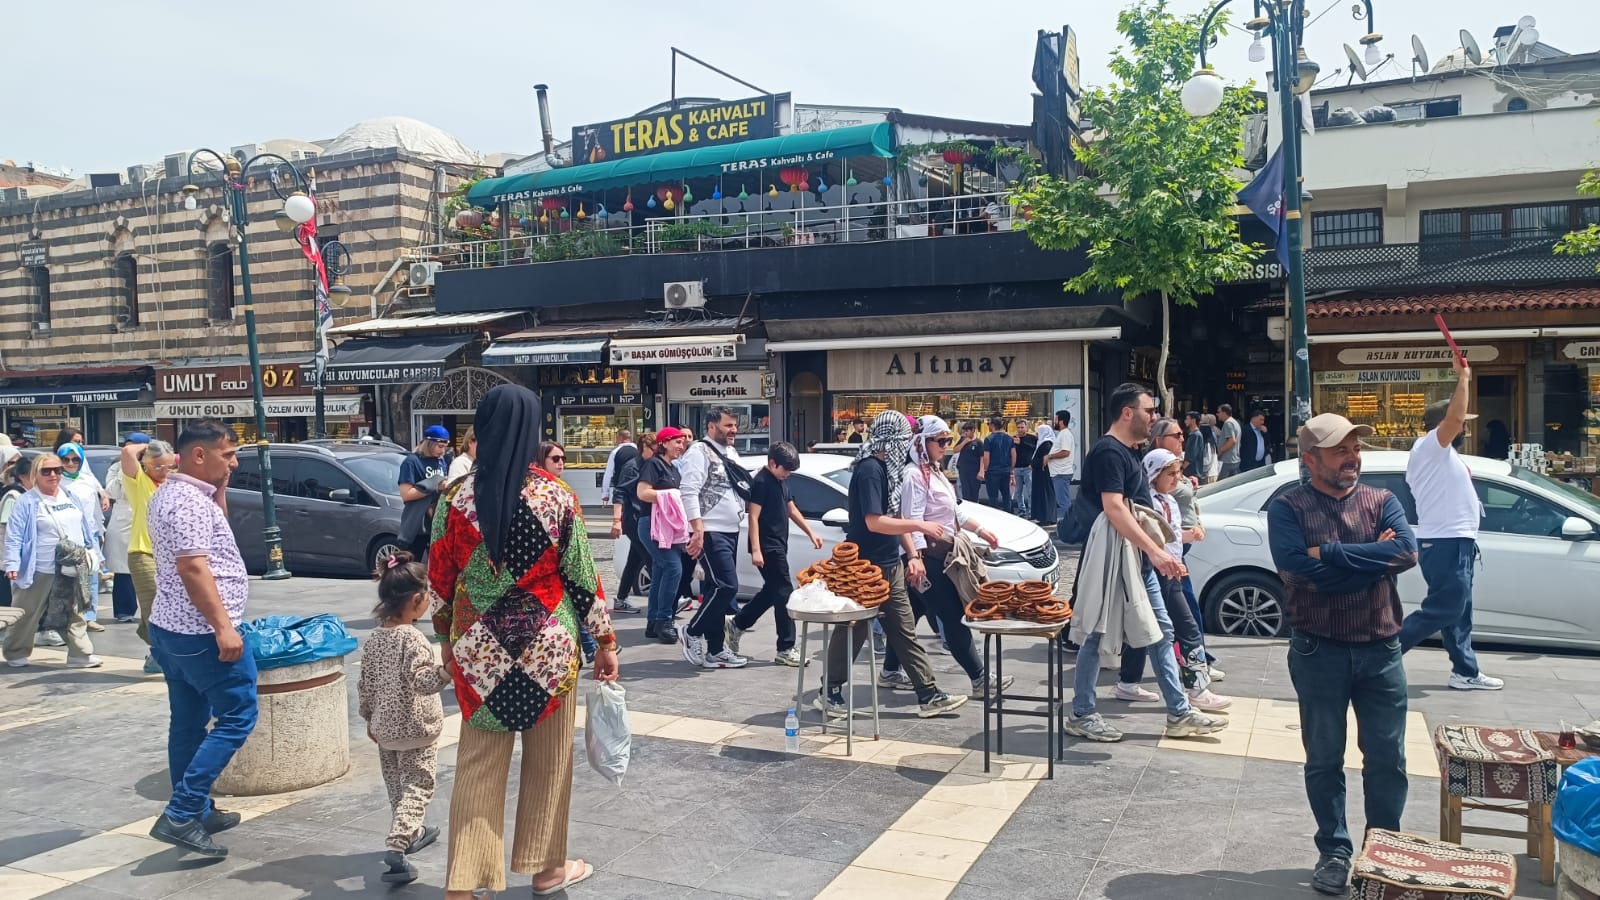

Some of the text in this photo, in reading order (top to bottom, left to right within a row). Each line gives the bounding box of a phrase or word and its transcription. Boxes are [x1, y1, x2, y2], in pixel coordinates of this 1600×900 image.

[610, 101, 766, 154] TERAS KAHVALTI
[688, 121, 748, 142] & CAFE
[720, 151, 834, 173] TERAS Kahvaltı & Cafe
[493, 190, 530, 203] TERAS
[567, 184, 583, 193] Cafe
[631, 347, 713, 362] BAŞAK GÜMÜŞÇÜLÜK
[1366, 349, 1468, 361] ASLAN KUYUMCUU
[886, 351, 1016, 378] Altınay
[338, 369, 400, 381] KUYUMCULAR
[701, 374, 738, 386] BAŞAK
[1357, 370, 1379, 383] ASLAN
[1380, 369, 1421, 382] KUYUMCUSU
[163, 373, 217, 393] UMUT
[220, 380, 248, 390] GOLD
[93, 393, 118, 401] TOPRAK
[689, 386, 748, 397] Gümüşçülük
[21, 396, 36, 404] GOLD
[169, 404, 235, 416] UMUT GOLD
[267, 405, 292, 414] ÖZLEM
